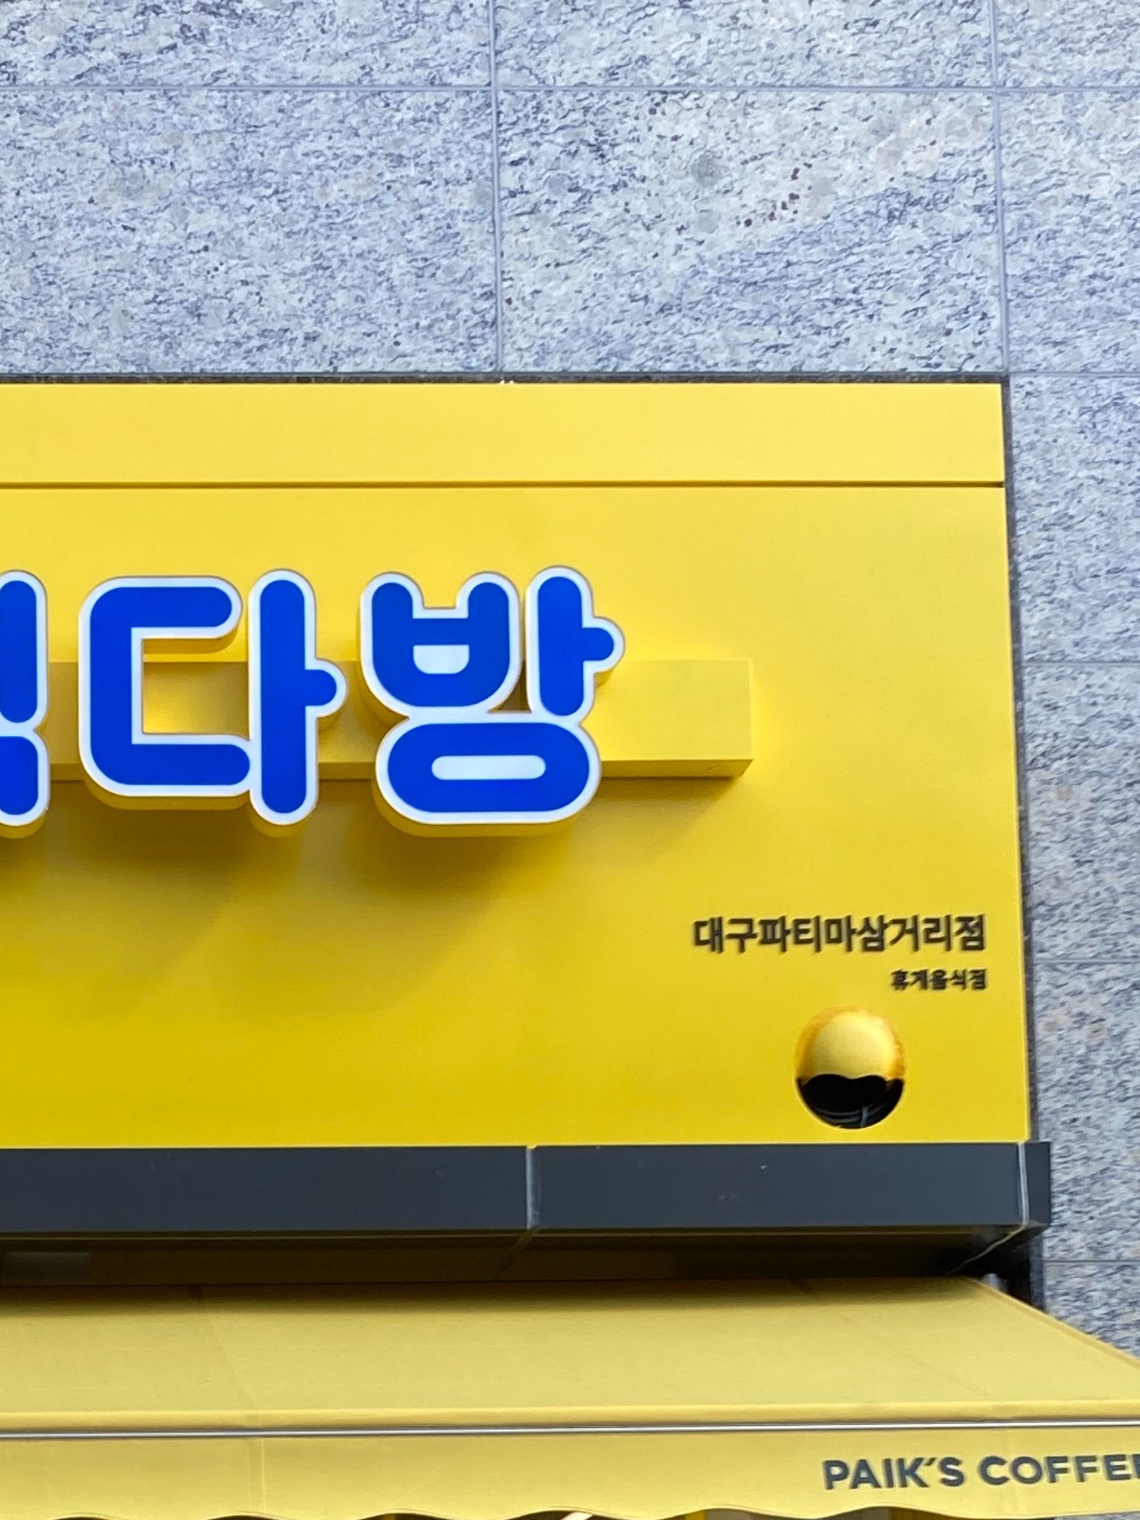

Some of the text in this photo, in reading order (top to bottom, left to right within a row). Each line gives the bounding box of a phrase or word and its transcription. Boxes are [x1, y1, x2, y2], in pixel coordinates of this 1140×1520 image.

[693, 913, 986, 954] 대구파티마삼거리점
[890, 968, 987, 991] 휴게음식점
[822, 1456, 965, 1490] PAIK'S
